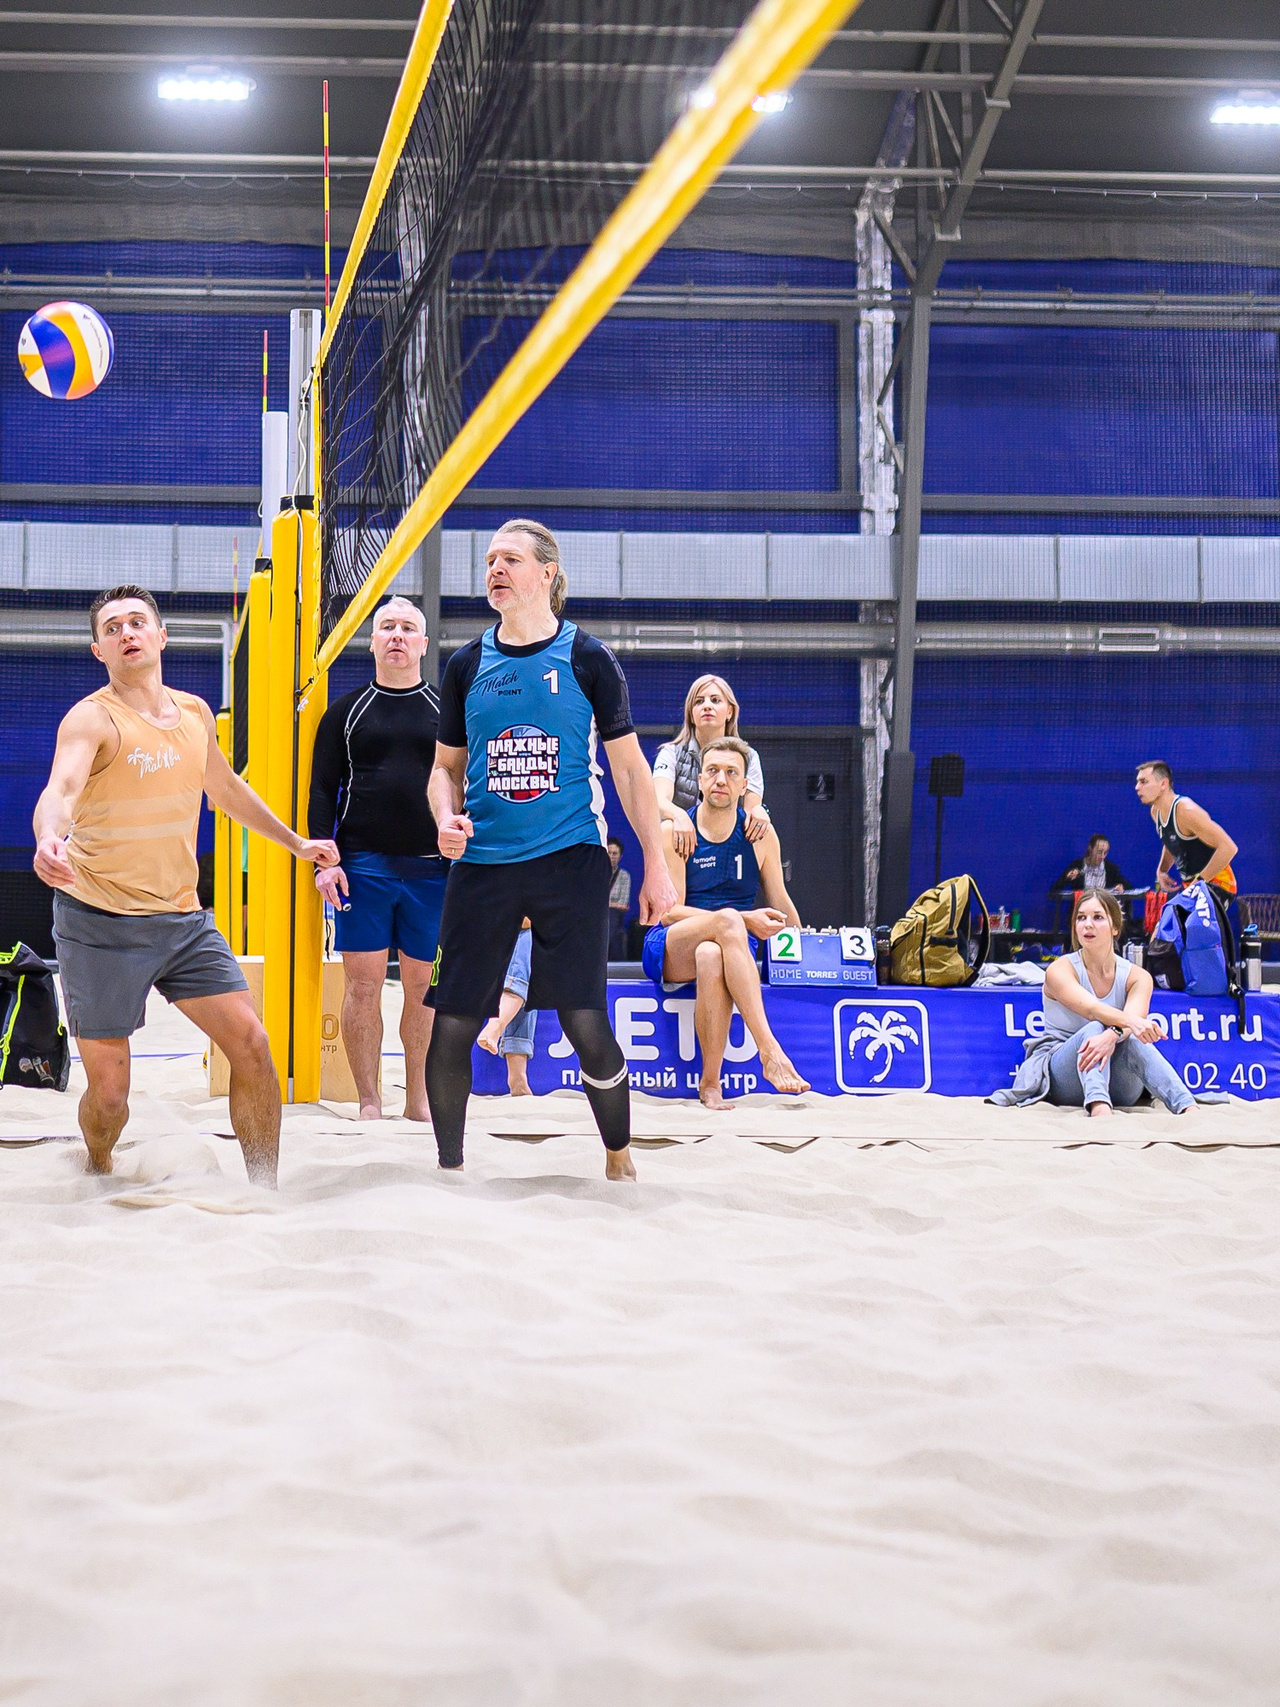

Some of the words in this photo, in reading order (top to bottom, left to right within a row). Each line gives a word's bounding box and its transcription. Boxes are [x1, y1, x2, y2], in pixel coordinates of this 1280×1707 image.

[475, 670, 519, 696] Match
[542, 669, 559, 694] 1
[487, 737, 559, 757] ПЛЯЖНЫЕ
[497, 755, 557, 775] БАНДЫ
[487, 775, 560, 792] МОСКВЫ
[734, 854, 743, 880] 1
[777, 933, 795, 957] 2
[849, 935, 866, 956] 3
[770, 969, 801, 979] HOME
[806, 970, 838, 979] TORRES
[842, 970, 874, 981] GUEST
[686, 1072, 758, 1094] цнтр
[1183, 1062, 1220, 1089] 02
[1229, 1063, 1267, 1090] 40
